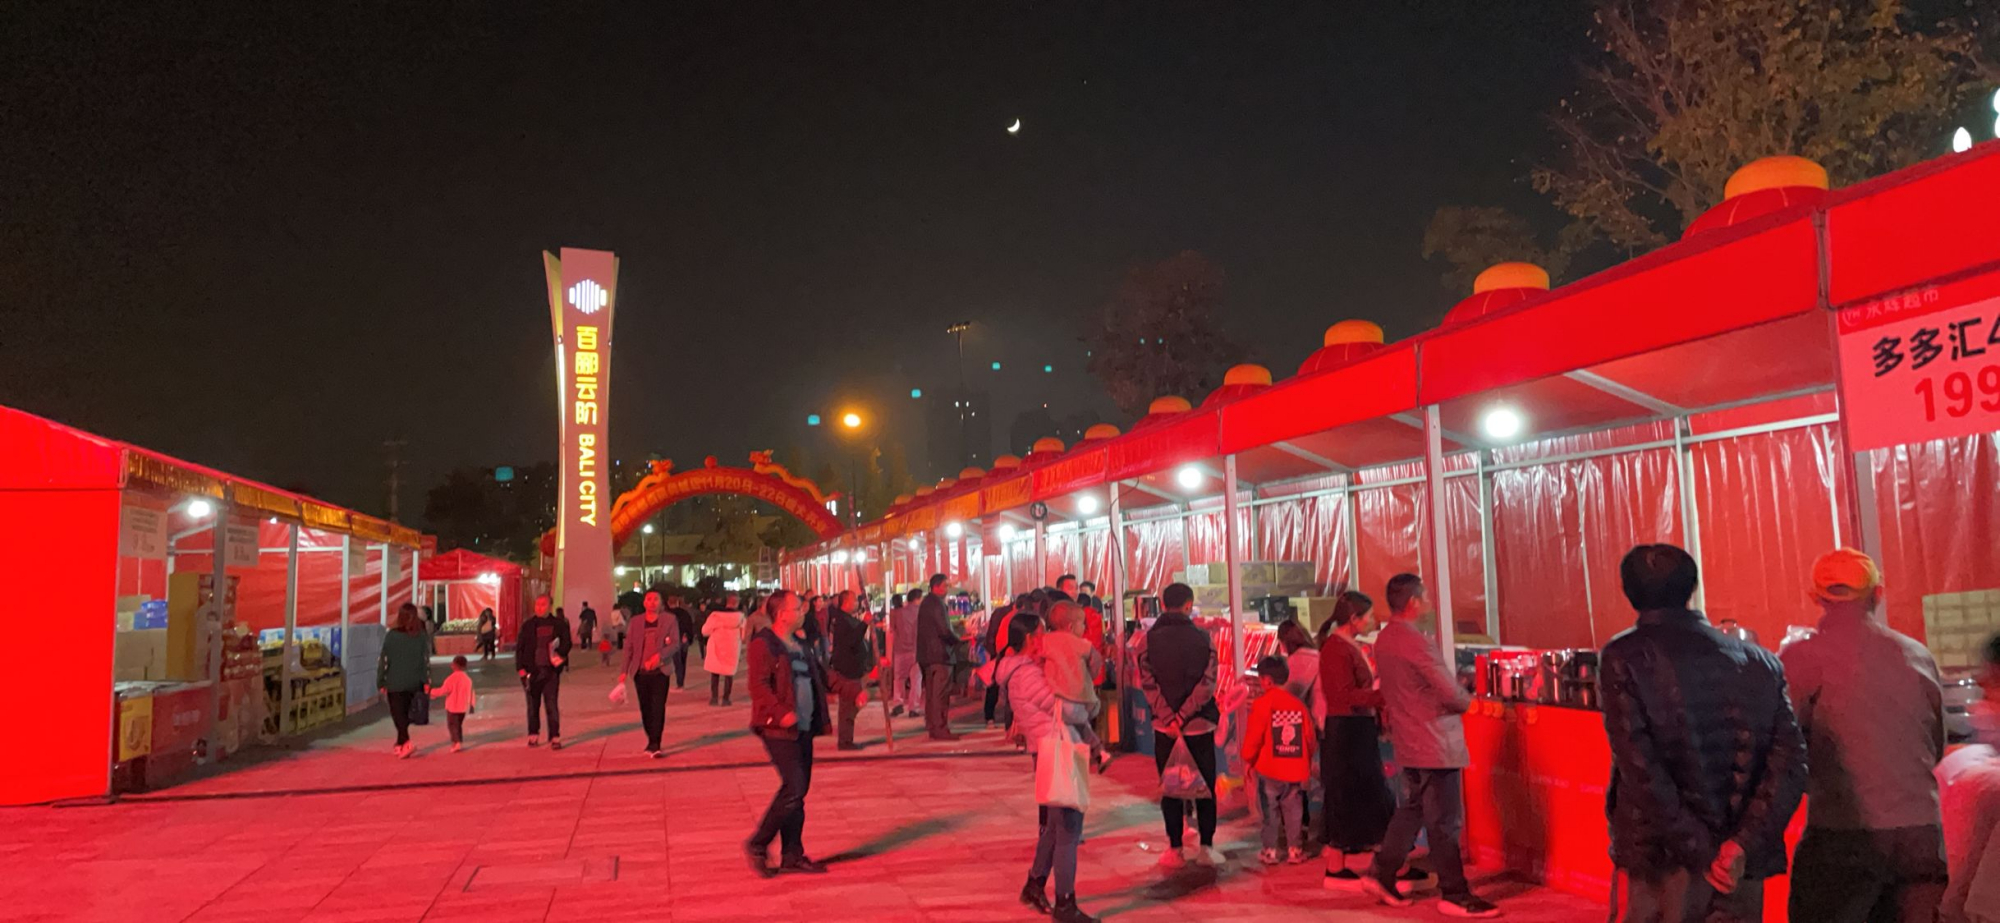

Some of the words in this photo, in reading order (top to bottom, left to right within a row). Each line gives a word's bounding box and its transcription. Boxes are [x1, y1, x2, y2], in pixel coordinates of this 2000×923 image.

[1915, 365, 2000, 422] 199
[579, 433, 596, 477] BALI
[579, 480, 596, 527] CITY
